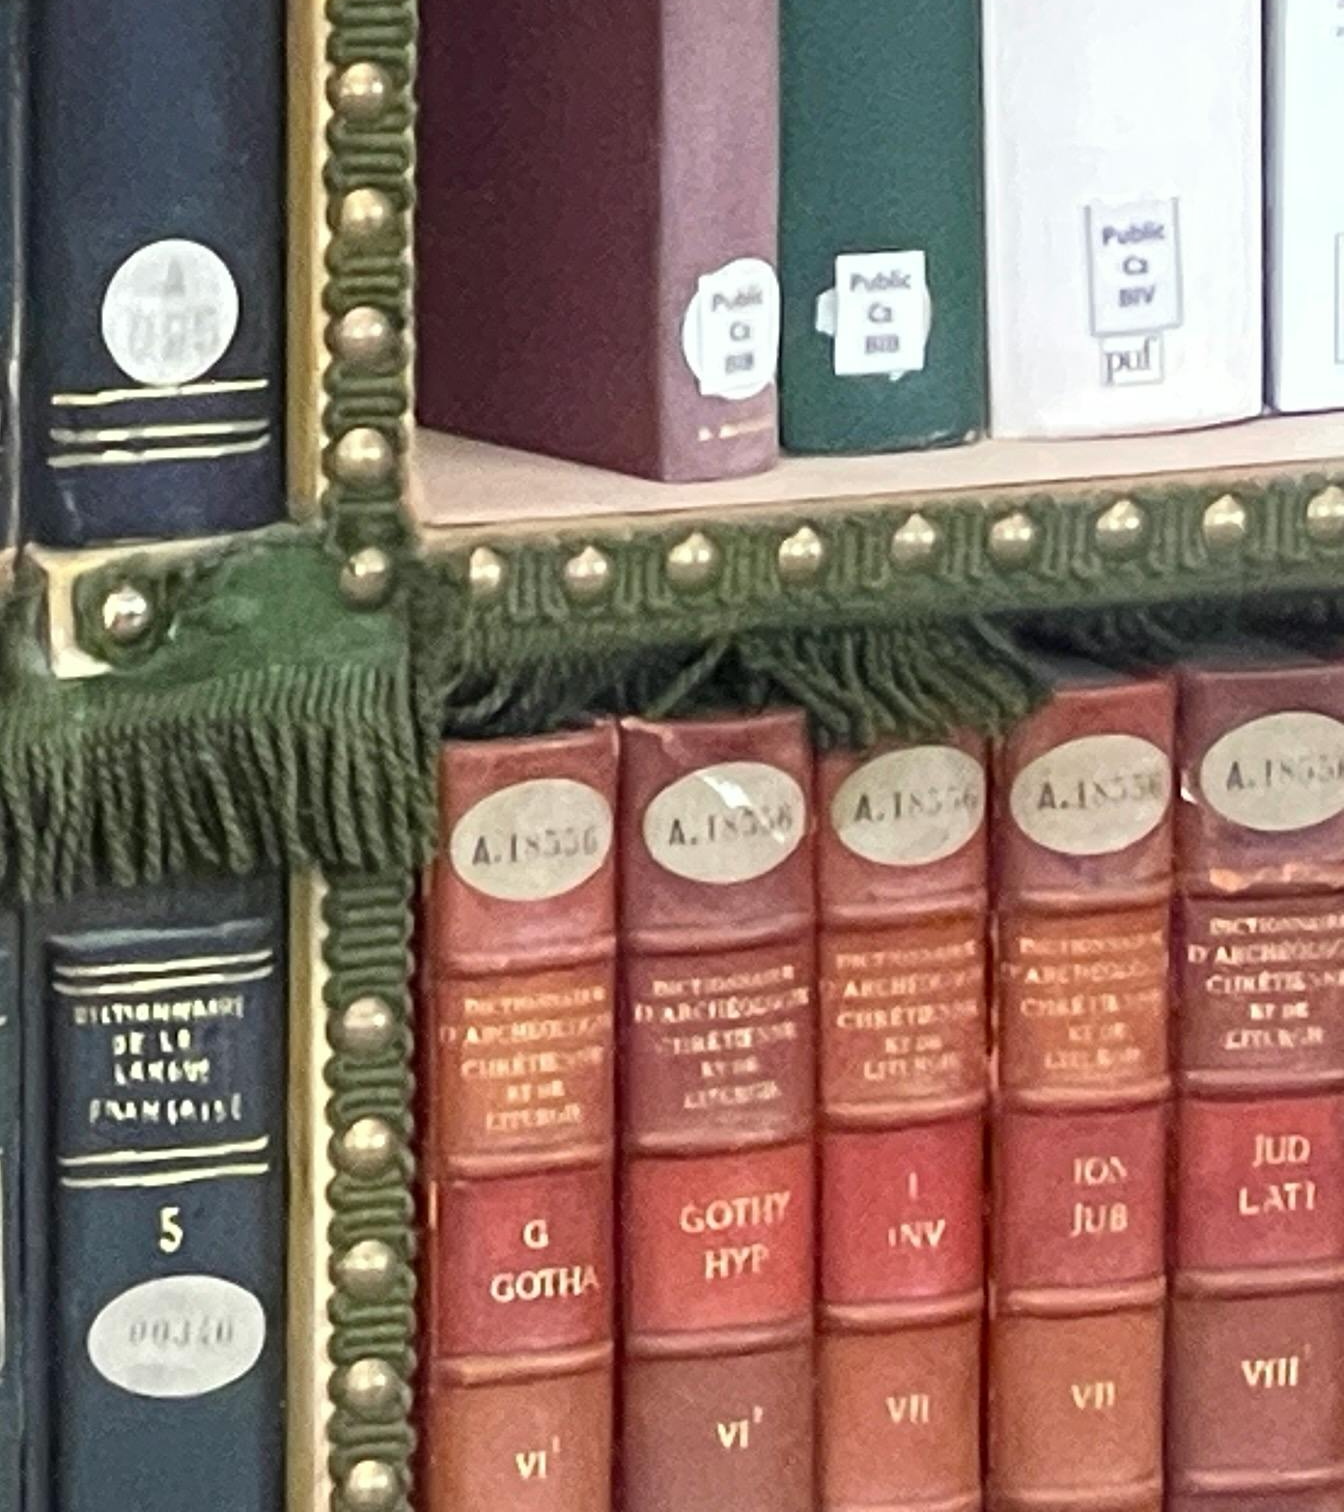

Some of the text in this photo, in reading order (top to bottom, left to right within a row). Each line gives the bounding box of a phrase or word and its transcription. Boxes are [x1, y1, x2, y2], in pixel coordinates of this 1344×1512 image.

[1101, 221, 1166, 246] Public
[849, 269, 912, 292] Public
[1104, 335, 1157, 387] puf
[1251, 1133, 1311, 1169] JUD
[908, 1171, 918, 1200] I
[1238, 1182, 1317, 1216] LATI
[158, 1206, 184, 1254] 5
[678, 1191, 792, 1235] GOTHY
[1068, 1201, 1129, 1238] JUB
[522, 1218, 550, 1249] G
[887, 1218, 947, 1249] INV
[704, 1244, 771, 1281] HYP
[489, 1264, 600, 1304] GOTHA
[885, 1393, 930, 1424] VII
[1070, 1381, 1116, 1410] VII
